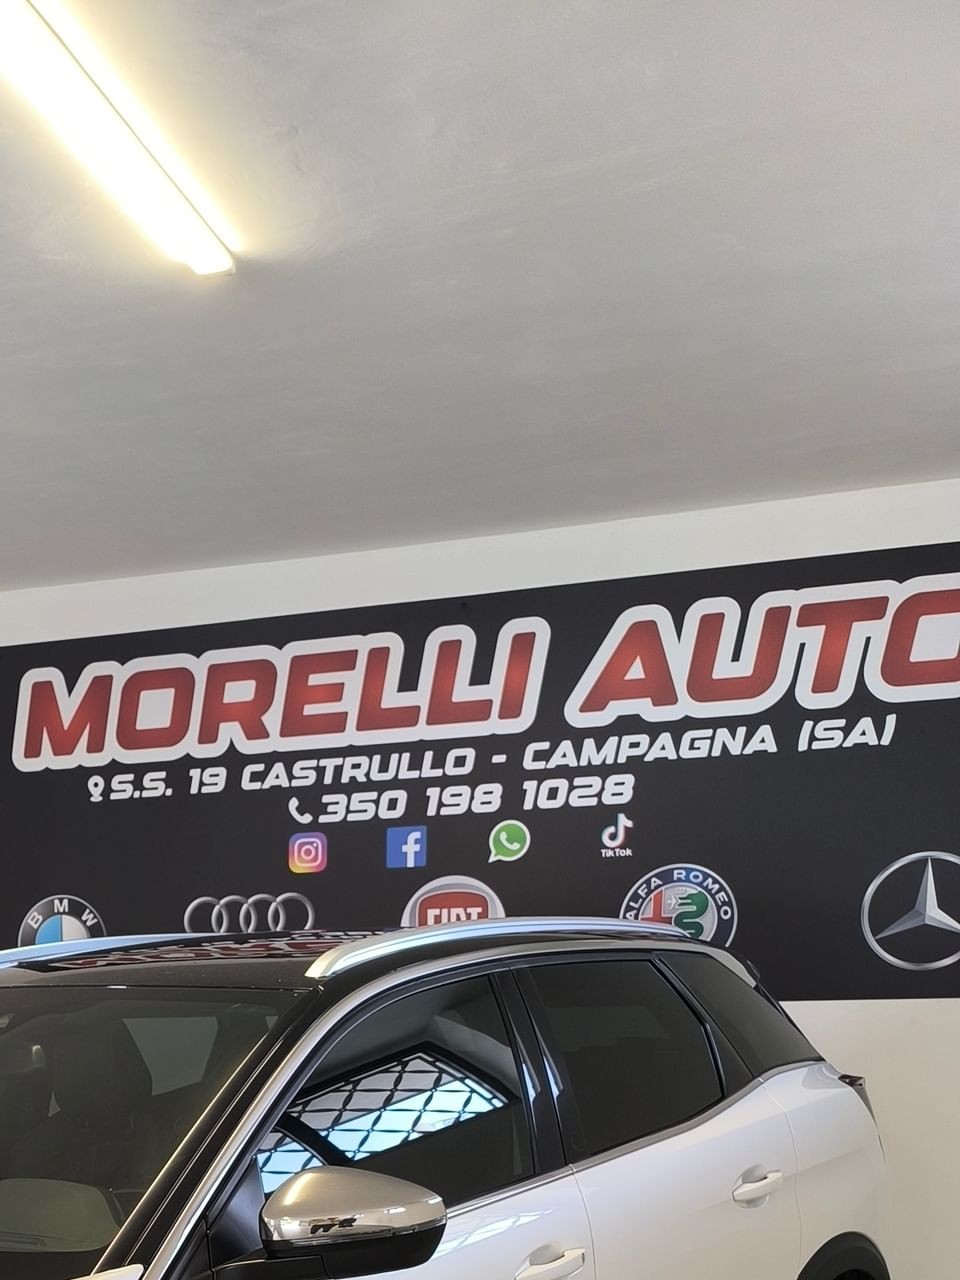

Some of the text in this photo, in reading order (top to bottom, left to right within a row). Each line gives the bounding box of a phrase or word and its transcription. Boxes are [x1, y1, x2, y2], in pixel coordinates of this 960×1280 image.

[16, 579, 960, 769] MORELLI AUTO
[110, 773, 173, 800] S.S.
[189, 767, 227, 794] 19
[241, 748, 476, 791] CASTRULLO
[522, 725, 778, 771] CAMPAGNA
[798, 714, 897, 752] (SA)
[318, 774, 636, 824] 350 198 1028
[600, 848, 633, 858] TikTok
[27, 898, 98, 929] BMW
[625, 869, 732, 920] ALFA ROMEO
